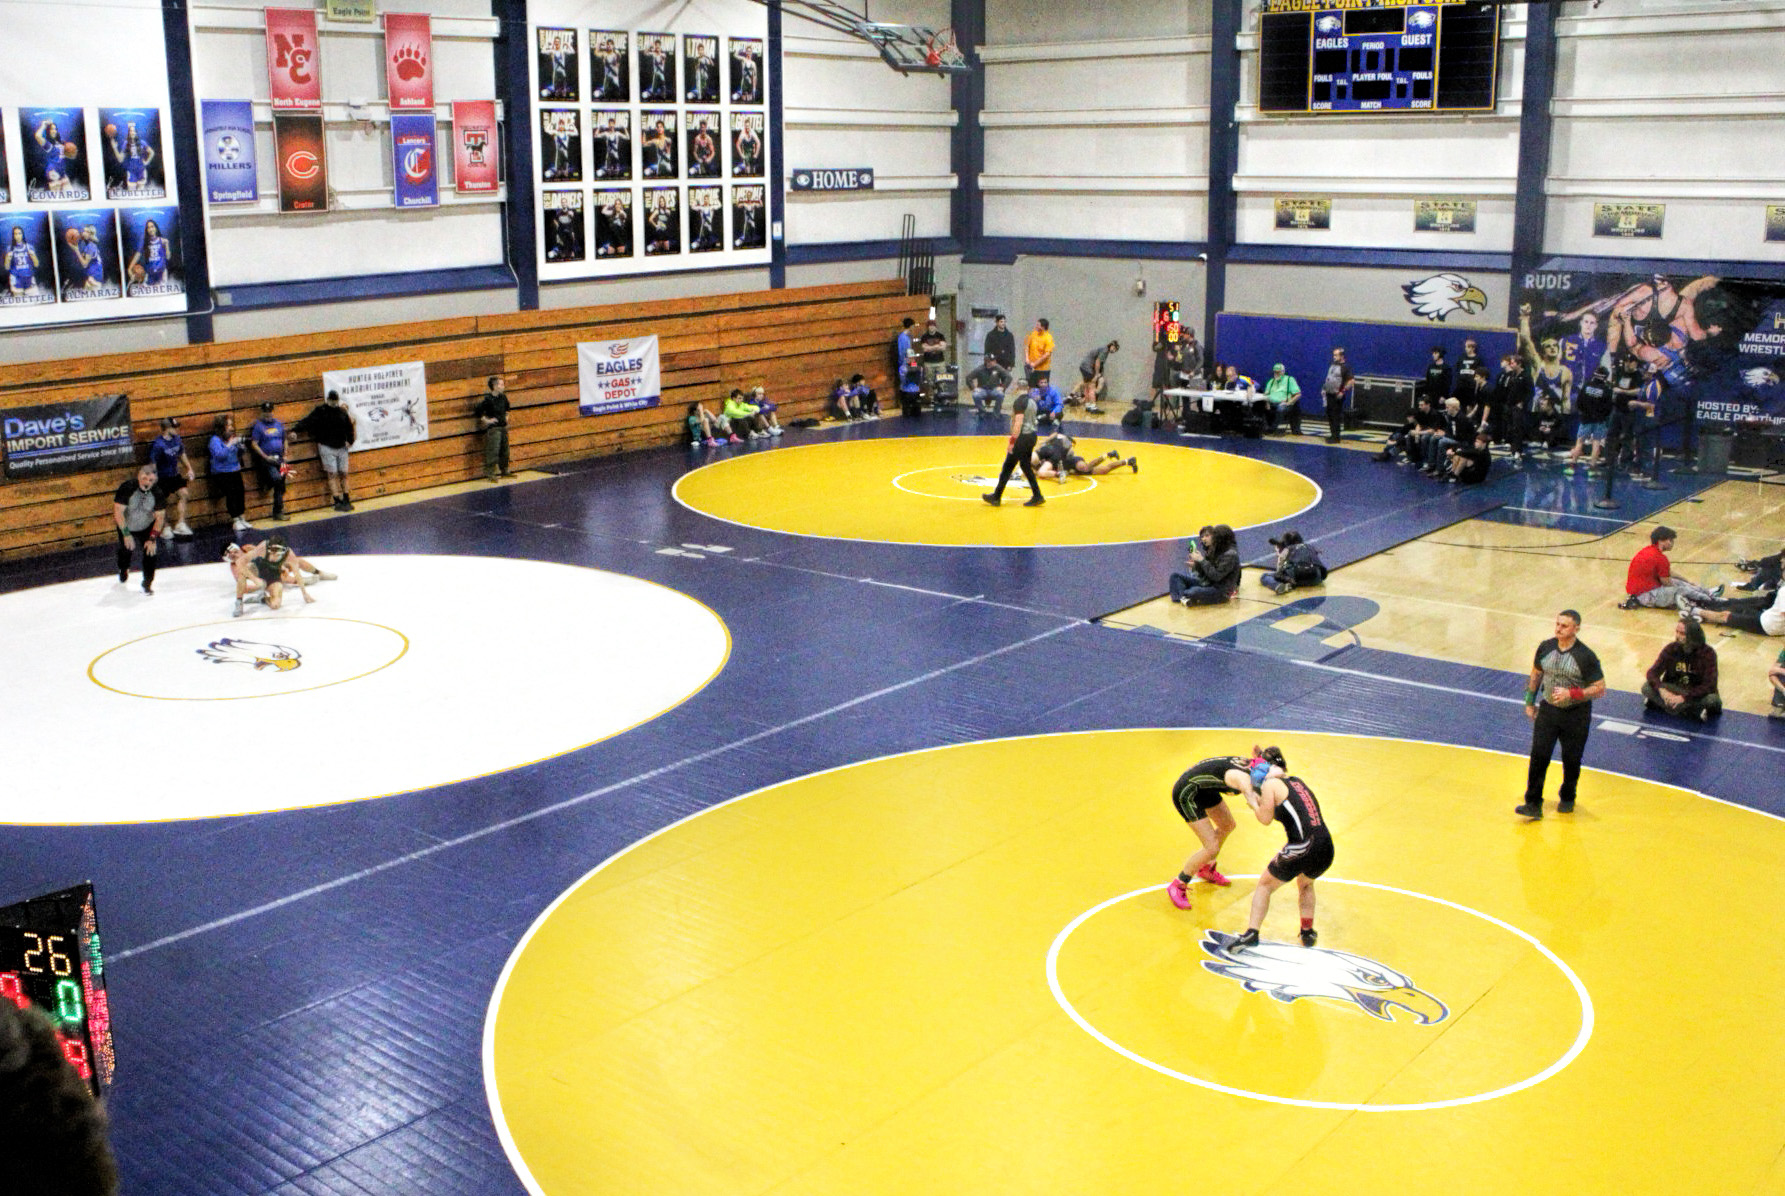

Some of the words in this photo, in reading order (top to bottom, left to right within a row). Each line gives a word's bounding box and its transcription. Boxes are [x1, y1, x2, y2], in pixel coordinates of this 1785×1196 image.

[333, 8, 352, 16] Eagle
[1316, 38, 1349, 49] EAGLES
[1401, 34, 1432, 45] GUEST
[1362, 41, 1384, 49] PERIOD
[1314, 74, 1333, 82] FOULS
[1352, 73, 1376, 81] PLAYER
[1377, 72, 1393, 80] FOUL
[1412, 71, 1433, 79] FOULS
[273, 97, 292, 106] North
[294, 97, 320, 107] Eugene
[400, 97, 425, 105] Ashland
[1313, 102, 1332, 110] SCORE
[1360, 101, 1382, 109] MATCH
[1411, 100, 1432, 108] SCORE
[208, 161, 252, 170] MILLERS
[812, 170, 858, 189] HOME
[33, 190, 88, 199] EDWARDS
[212, 190, 253, 200] Springfield
[404, 196, 432, 205] Churchill
[1525, 274, 1572, 290] RUDIS
[0, 293, 54, 304] EDBETTER
[596, 358, 643, 375] EAGLES
[348, 373, 372, 383] HUNTER
[611, 377, 630, 388] GAS
[342, 384, 372, 394] MEMORIAL
[374, 378, 411, 390] TOURNAMENT
[605, 388, 636, 400] DEPOT
[1697, 401, 1740, 412] HOSTED
[1696, 410, 1731, 421] EAGLE
[4, 412, 85, 439] Dave's
[7, 434, 65, 452] IMPORT
[68, 425, 129, 445] SERVICE
[9, 458, 34, 470] Quality
[35, 454, 77, 466] Personalized
[78, 450, 100, 460] Service
[101, 447, 117, 456] Since
[24, 932, 72, 976] 26
